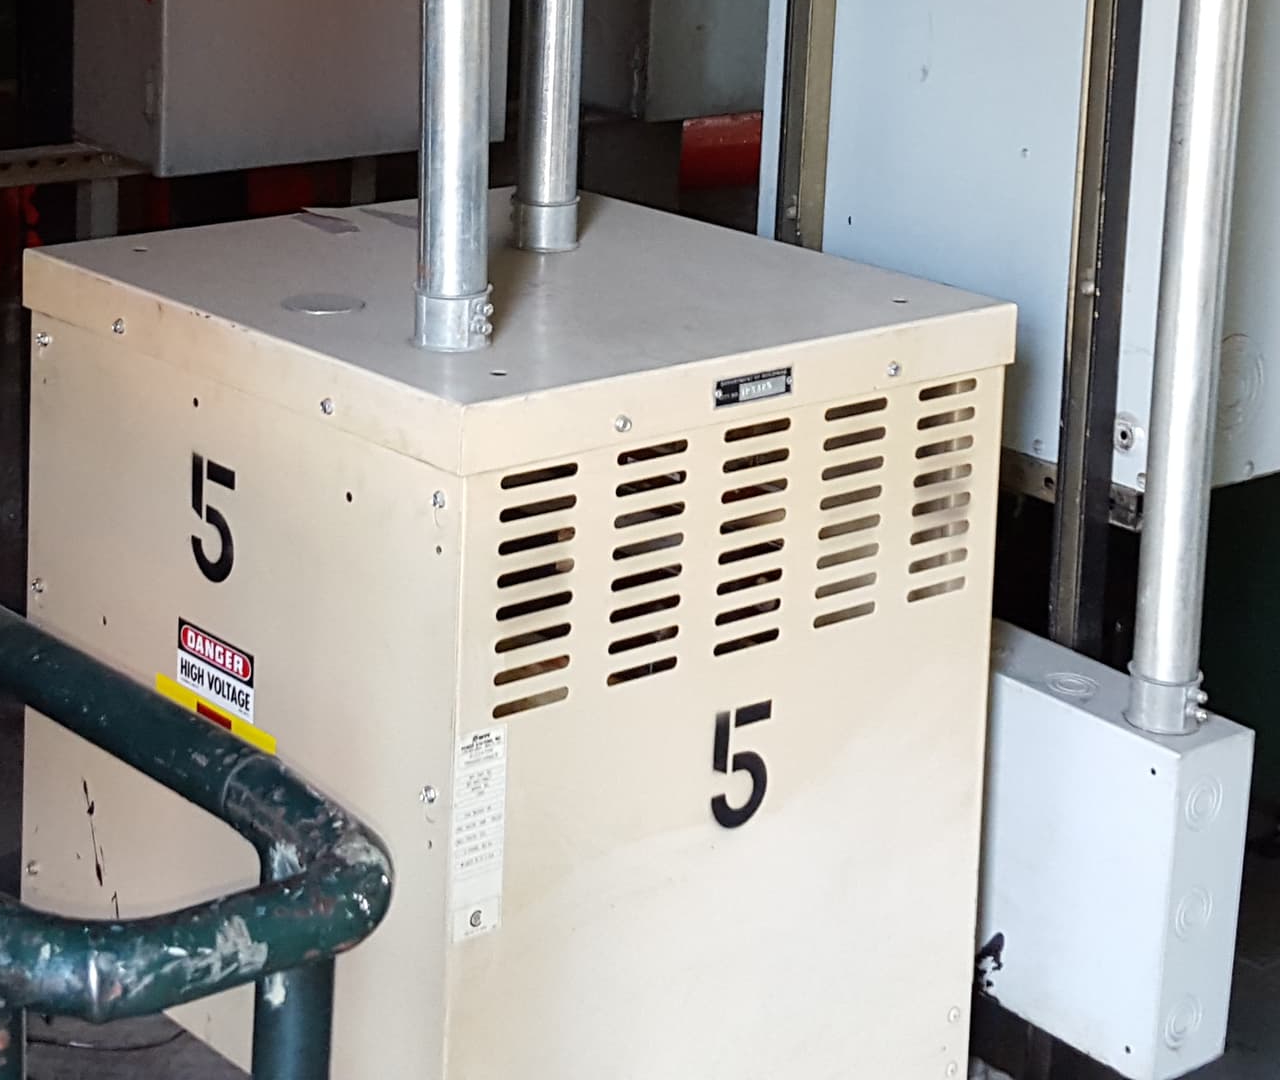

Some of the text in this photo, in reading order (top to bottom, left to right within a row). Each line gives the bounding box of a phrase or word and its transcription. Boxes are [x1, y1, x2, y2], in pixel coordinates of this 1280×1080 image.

[191, 452, 235, 583] 5
[180, 657, 250, 712] HIGH VOLTAGE
[187, 629, 243, 676] DANGER
[711, 699, 772, 828] 5
